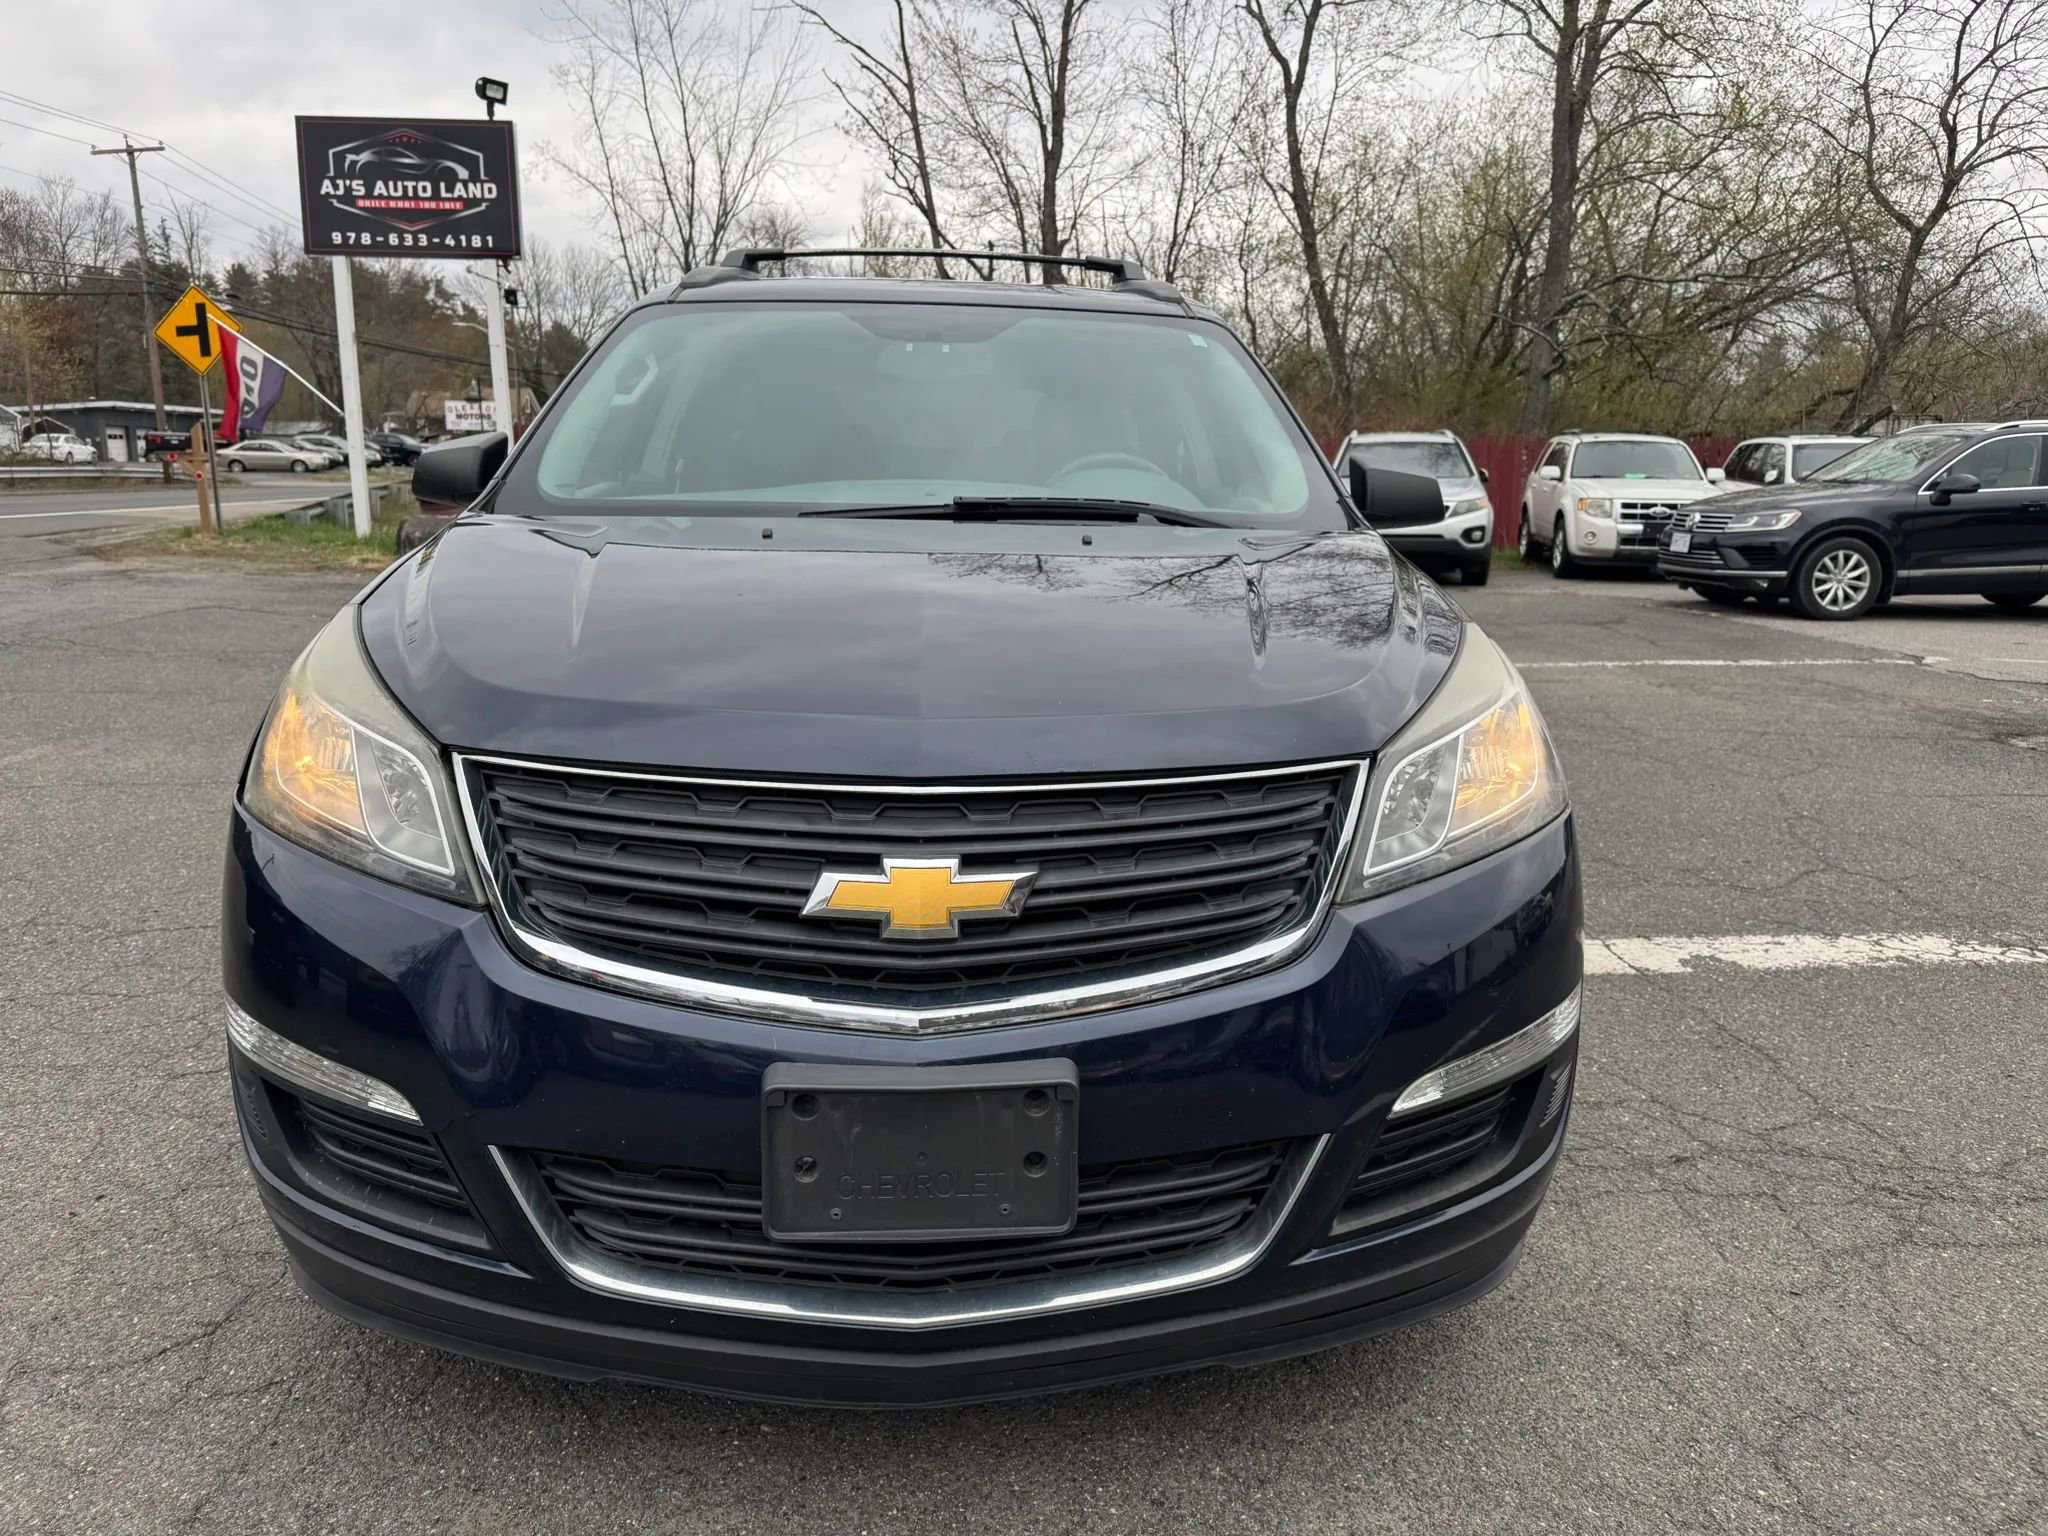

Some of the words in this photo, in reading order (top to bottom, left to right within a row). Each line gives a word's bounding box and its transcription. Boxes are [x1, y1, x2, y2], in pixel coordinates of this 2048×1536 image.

[320, 178, 366, 196] AJ'S
[373, 180, 432, 198] AUTO
[440, 182, 498, 199] LAND
[331, 231, 494, 248] 978-633-4181
[837, 1171, 1007, 1200] CHEVROLET
